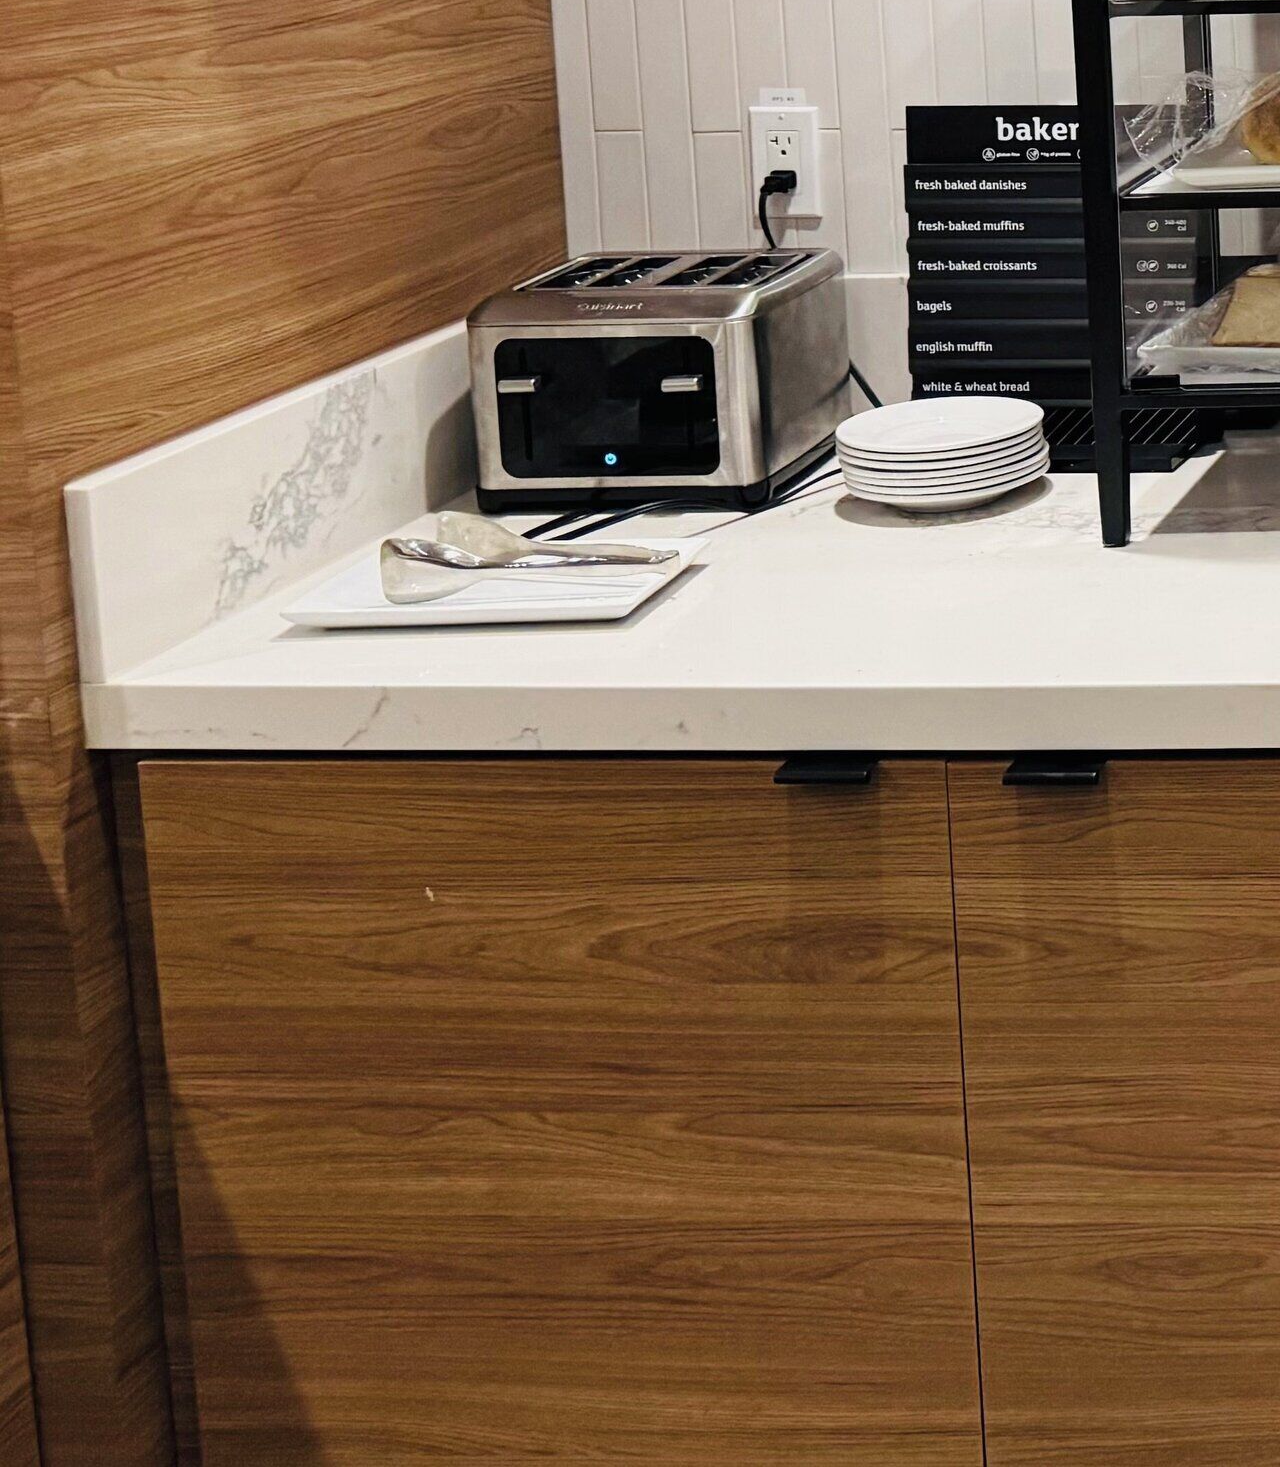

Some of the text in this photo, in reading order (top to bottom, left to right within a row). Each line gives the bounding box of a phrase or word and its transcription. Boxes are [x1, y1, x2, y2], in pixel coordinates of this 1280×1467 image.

[995, 116, 1079, 141] baker
[915, 180, 1027, 190] fresh baked danishes
[917, 220, 981, 231] fresh-baked
[983, 220, 1025, 231] muffins
[917, 260, 981, 271] fresh-baked
[983, 260, 1037, 271] croissants
[916, 301, 952, 313] bagels
[916, 341, 993, 354] english muffin
[922, 381, 1030, 392] white & wheat bread
